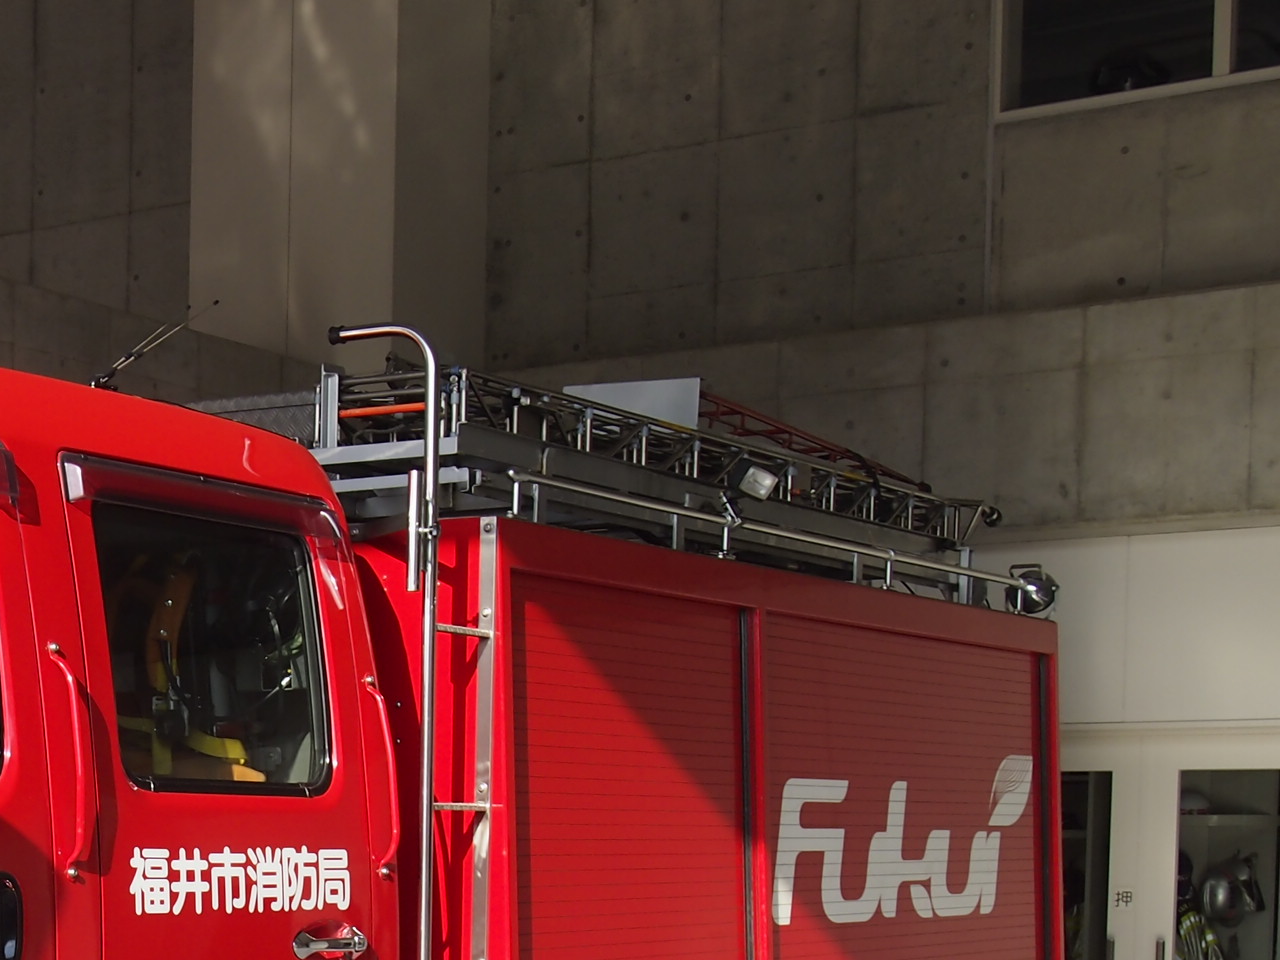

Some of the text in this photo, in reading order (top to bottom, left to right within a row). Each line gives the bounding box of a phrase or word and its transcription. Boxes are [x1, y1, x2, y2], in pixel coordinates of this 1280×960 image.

[771, 755, 1034, 926] Fukui
[129, 846, 351, 916] 福井市消防局
[1114, 890, 1132, 908] 押
